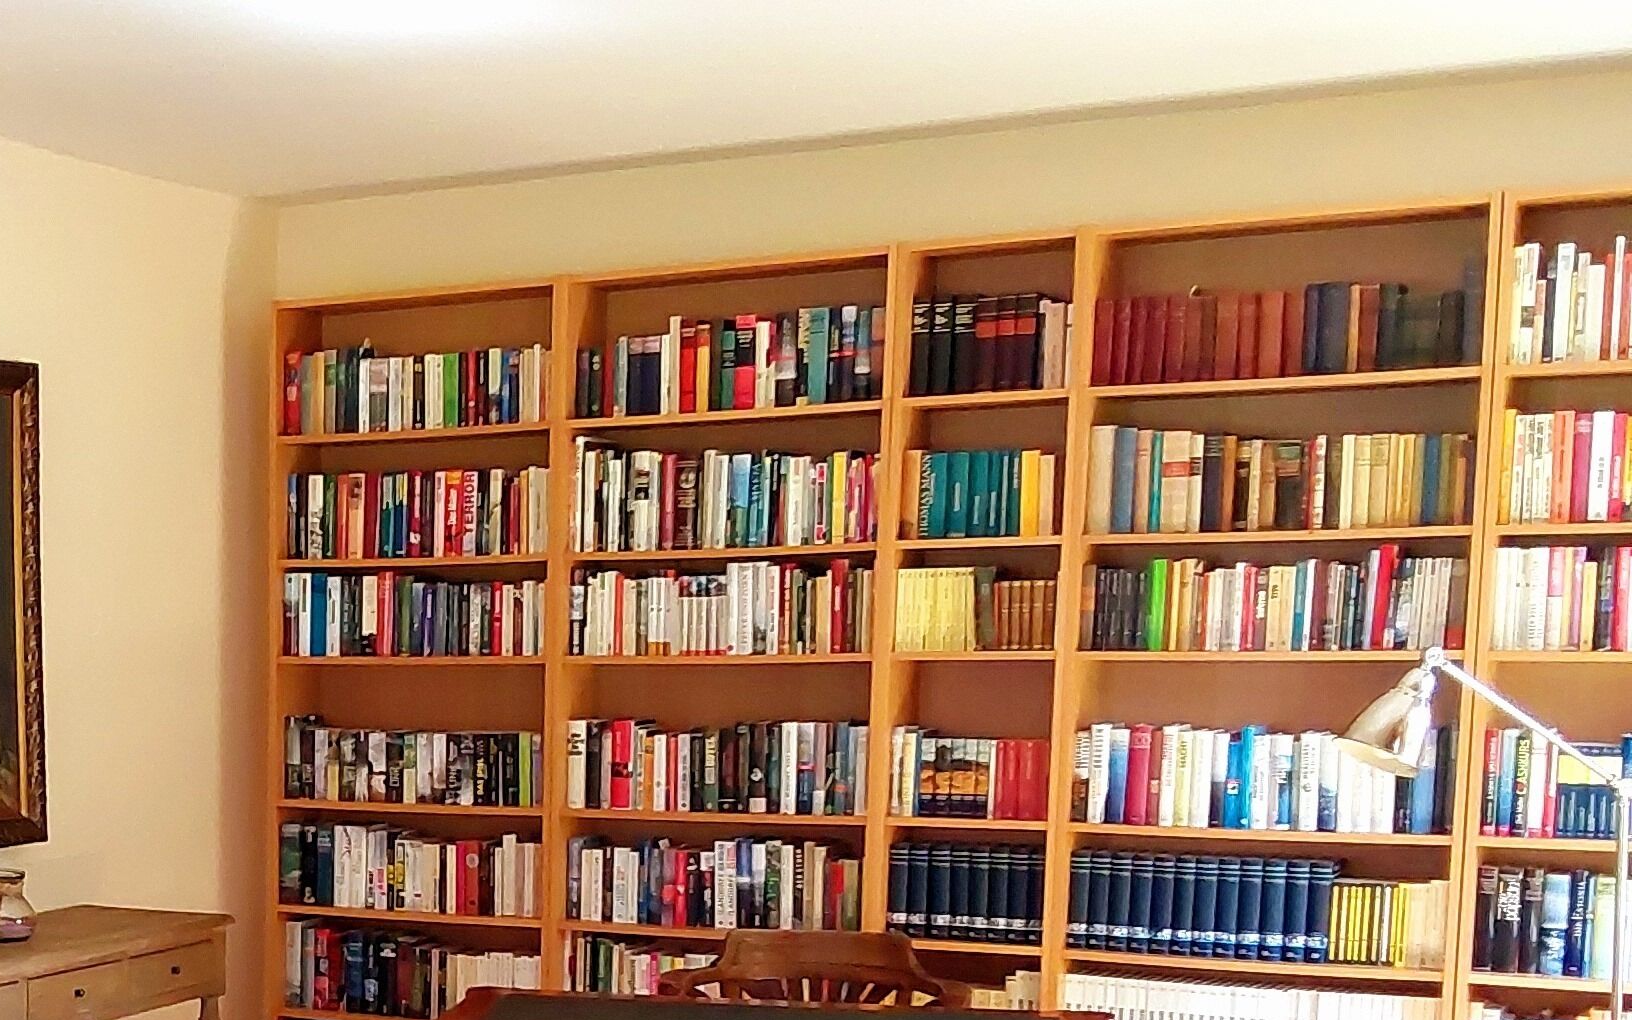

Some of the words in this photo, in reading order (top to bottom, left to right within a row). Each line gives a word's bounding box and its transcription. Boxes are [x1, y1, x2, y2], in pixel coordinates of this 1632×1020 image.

[920, 455, 932, 488] MANN
[464, 474, 474, 534] TERROR
[919, 490, 929, 535] THOMAS
[1515, 739, 1530, 795] CASHKURS
